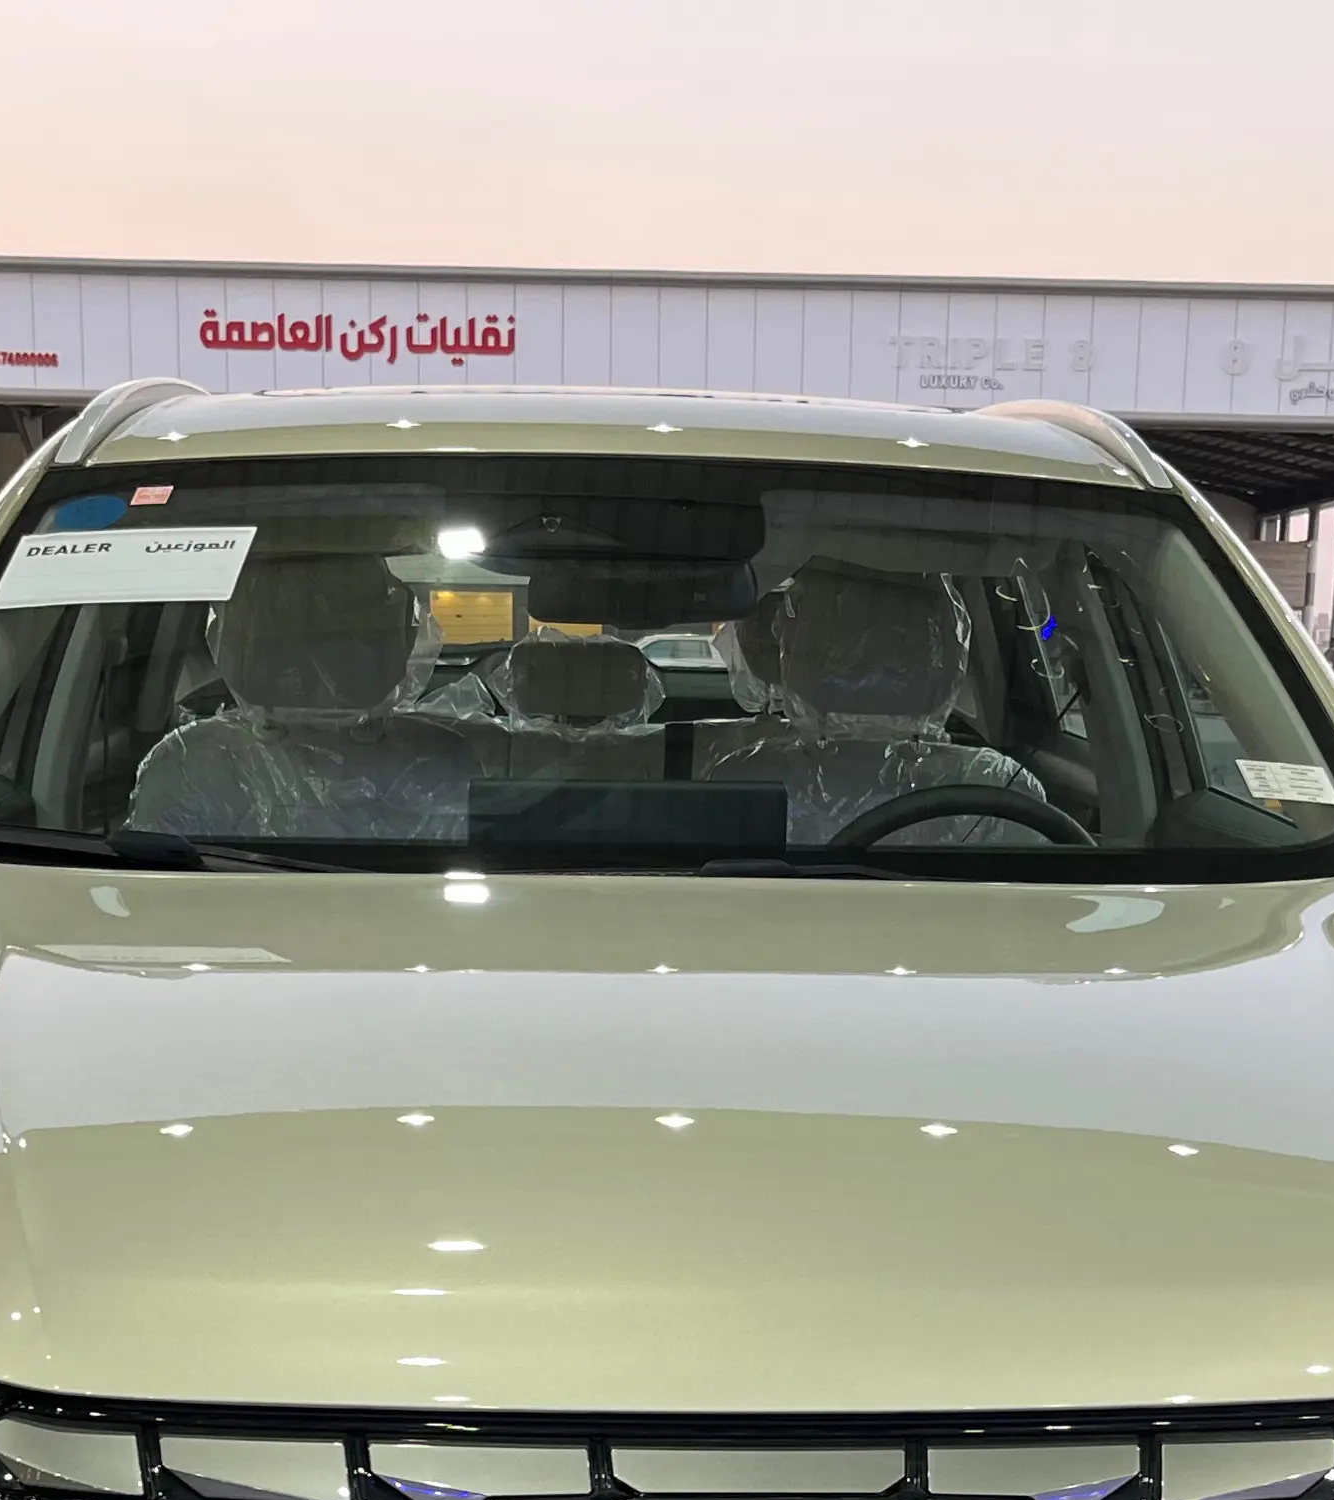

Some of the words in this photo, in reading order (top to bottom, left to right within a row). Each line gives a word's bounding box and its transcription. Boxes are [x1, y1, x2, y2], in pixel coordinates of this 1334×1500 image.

[199, 308, 332, 352] العاصمة
[340, 315, 398, 365] ركن
[406, 312, 515, 366] نقليات
[888, 336, 1048, 371] TRIPLE
[919, 374, 978, 390] LUXURY
[25, 542, 113, 558] DEALER
